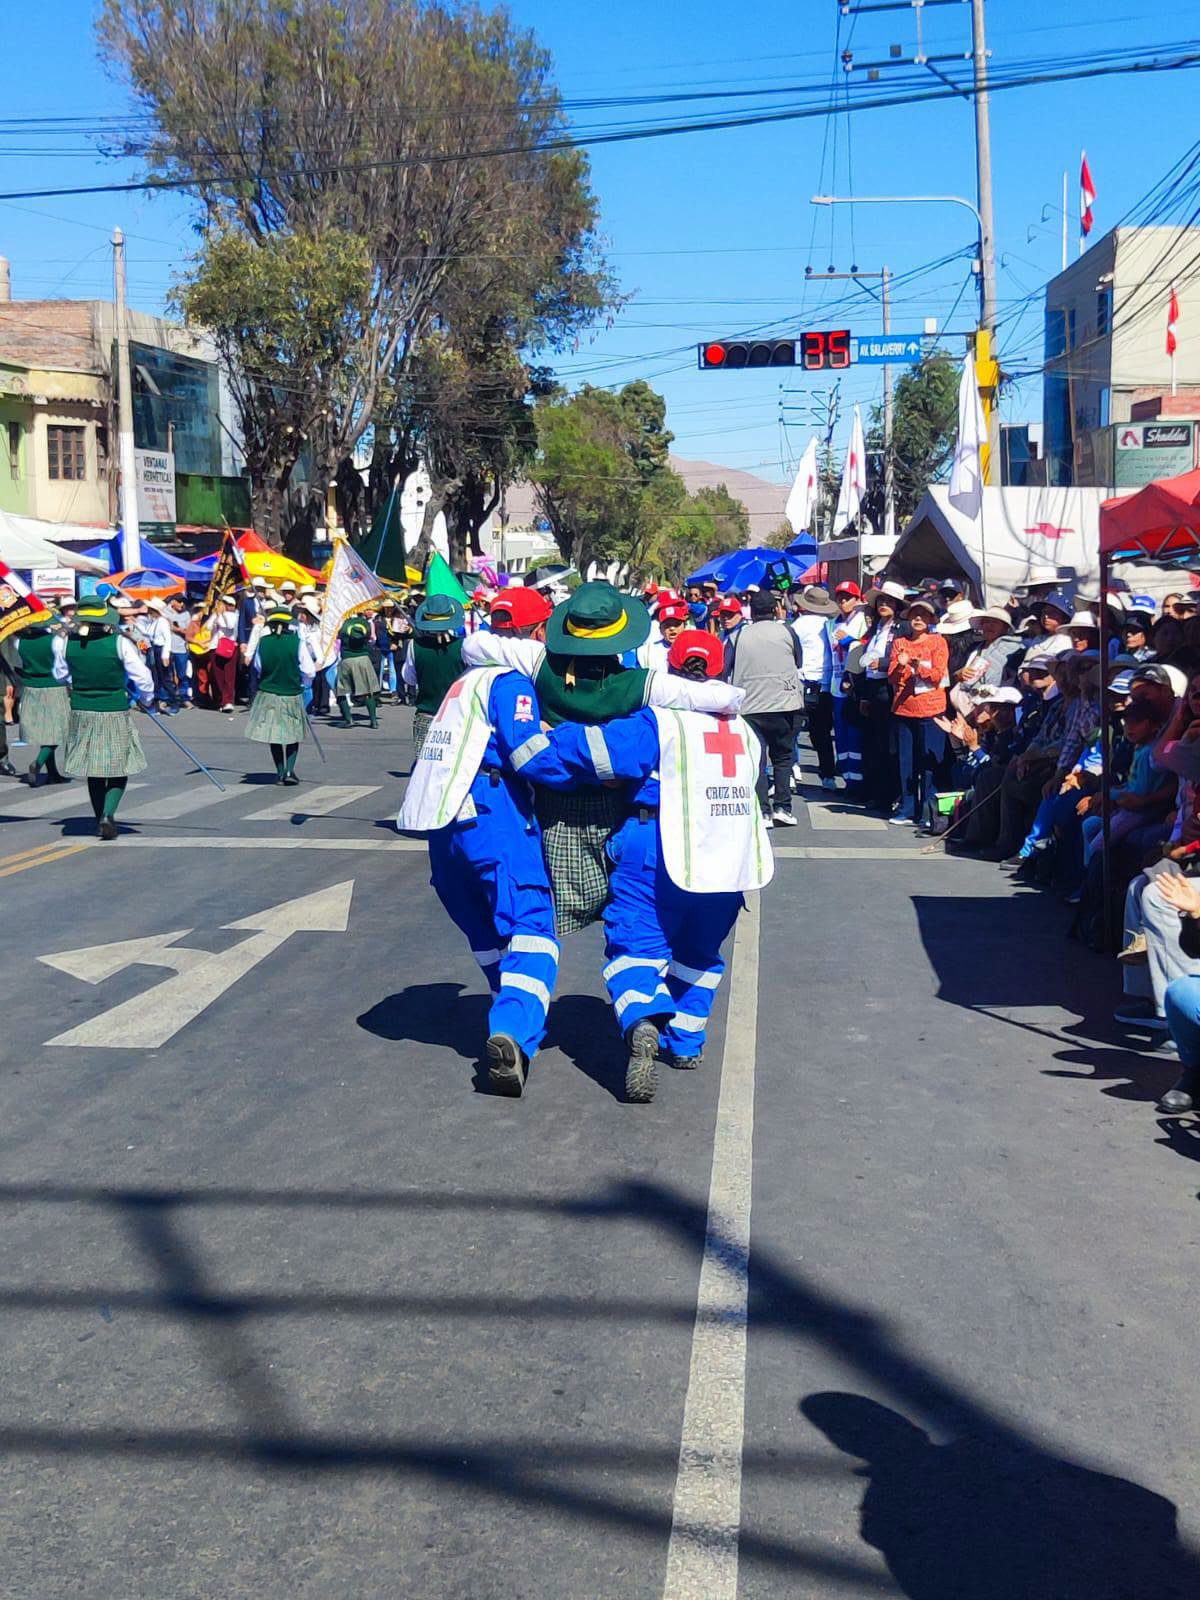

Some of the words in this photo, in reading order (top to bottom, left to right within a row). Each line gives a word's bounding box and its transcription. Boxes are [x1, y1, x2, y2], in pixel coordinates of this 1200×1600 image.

[805, 331, 849, 369] 35
[870, 342, 906, 356] SALAVERRY
[705, 786, 730, 800] CRUZ
[710, 802, 751, 816] PERUAN
